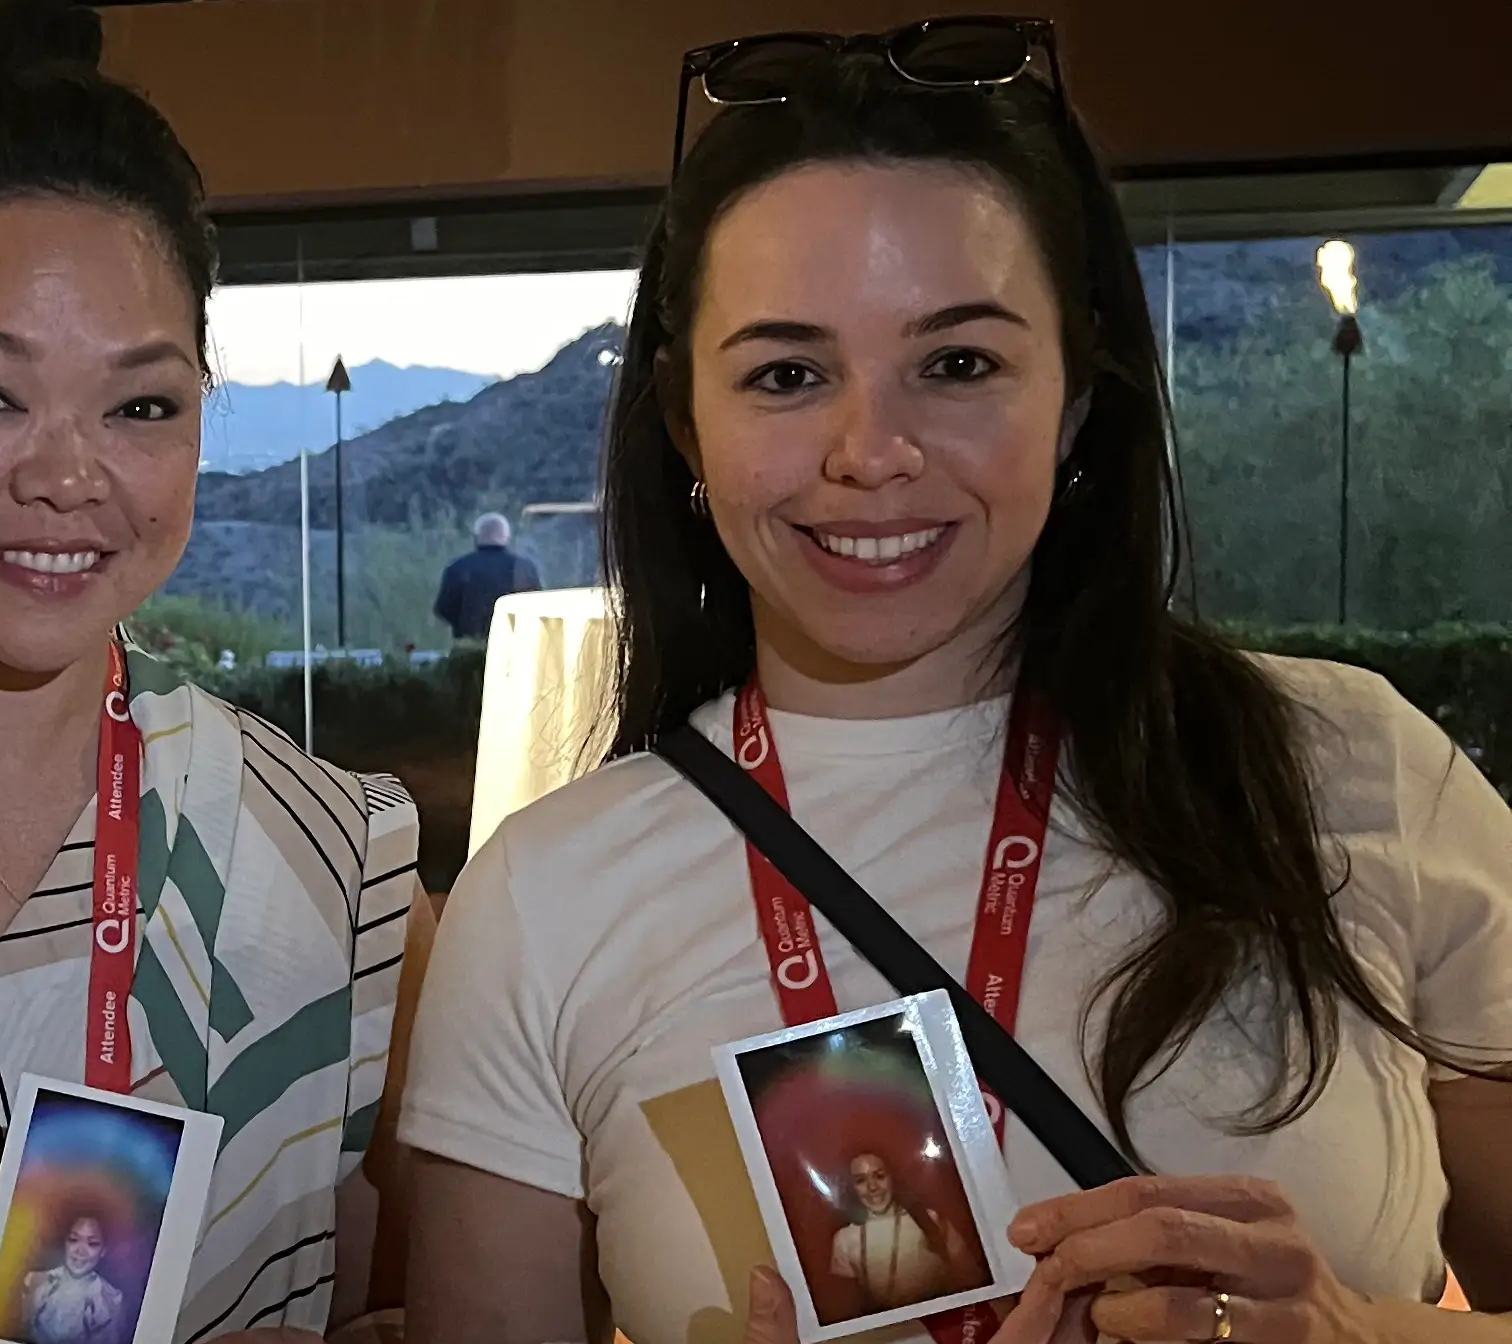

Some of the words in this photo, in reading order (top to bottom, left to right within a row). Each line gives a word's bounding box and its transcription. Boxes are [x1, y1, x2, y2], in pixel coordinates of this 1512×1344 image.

[108, 753, 125, 821] Attendee
[103, 854, 117, 914] Quantum
[118, 875, 132, 916] Metric
[100, 990, 117, 1064] Attendee
